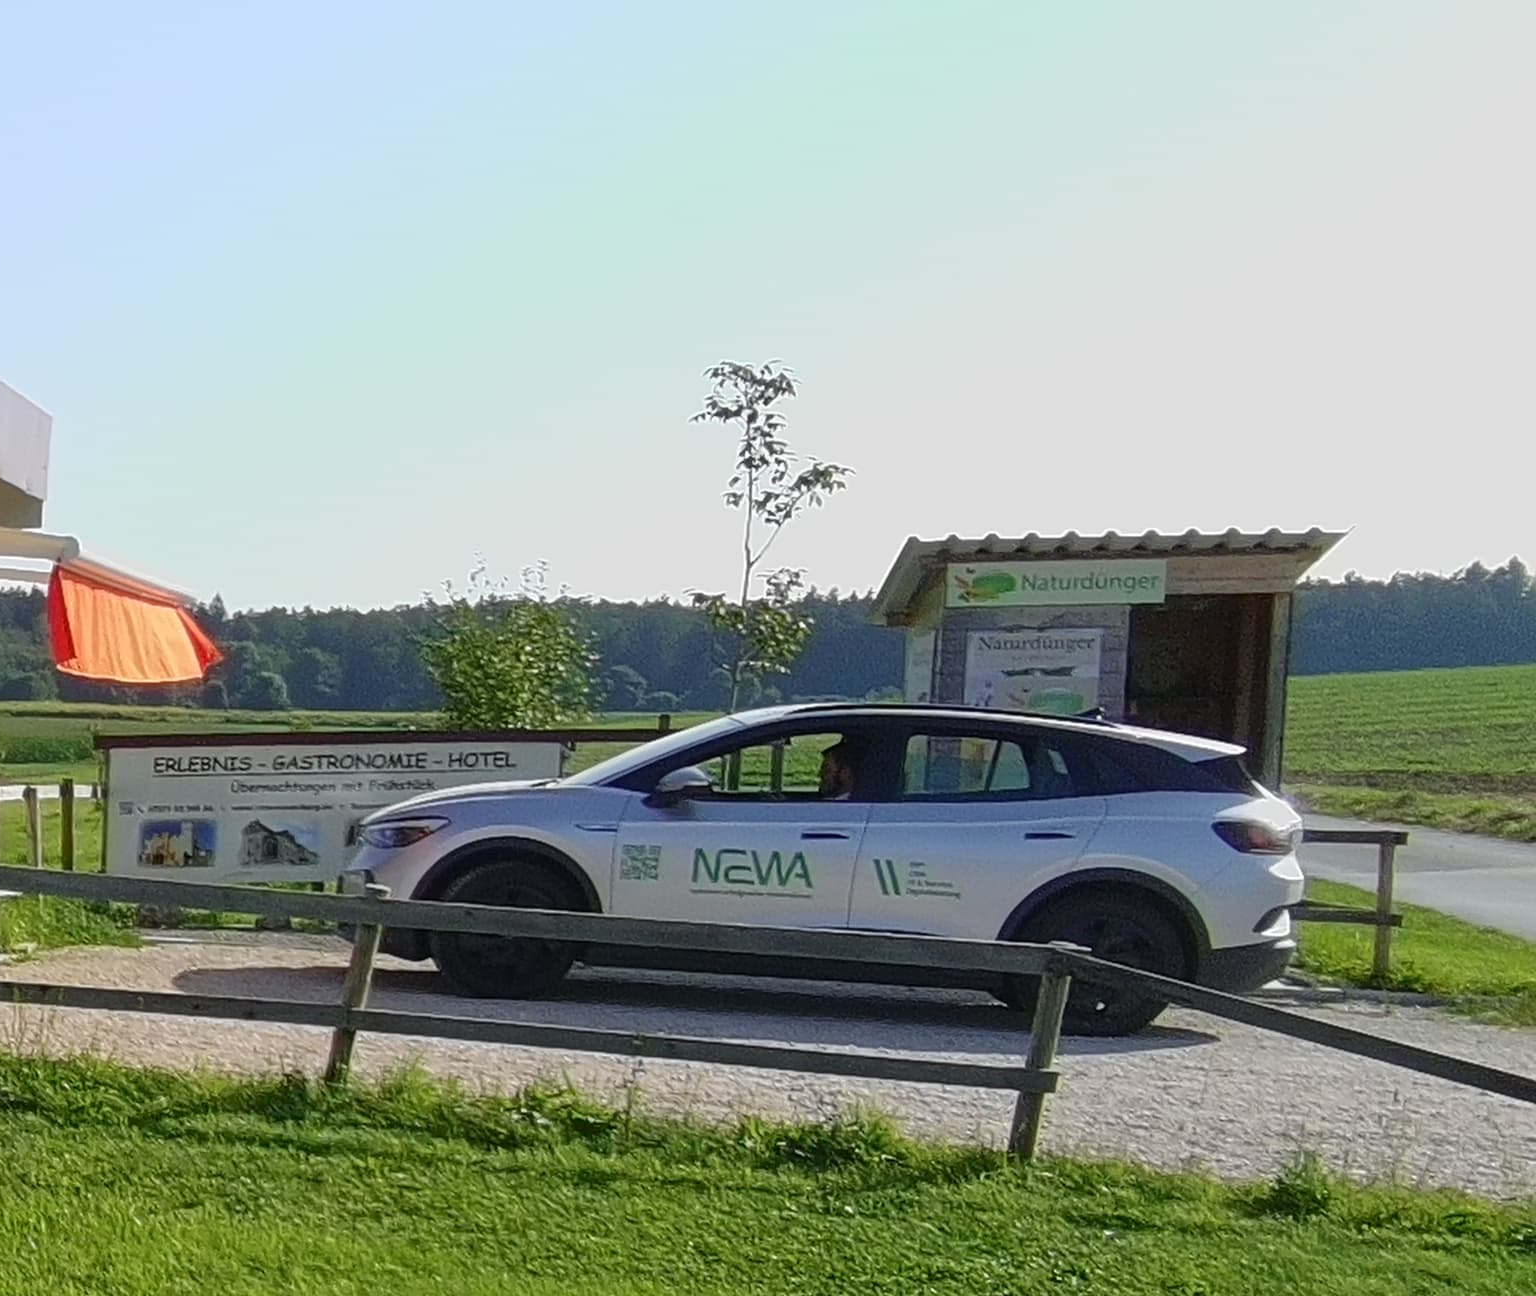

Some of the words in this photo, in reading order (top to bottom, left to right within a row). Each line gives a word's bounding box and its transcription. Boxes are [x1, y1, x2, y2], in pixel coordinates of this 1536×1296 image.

[1021, 569, 1160, 594] Naturdünger
[978, 636, 1096, 654] Naturdünger
[153, 756, 252, 773] ERLEBNIS
[271, 752, 428, 771] GASTRONOMIE
[448, 751, 517, 769] HOTEL
[690, 847, 814, 888] NEWA
